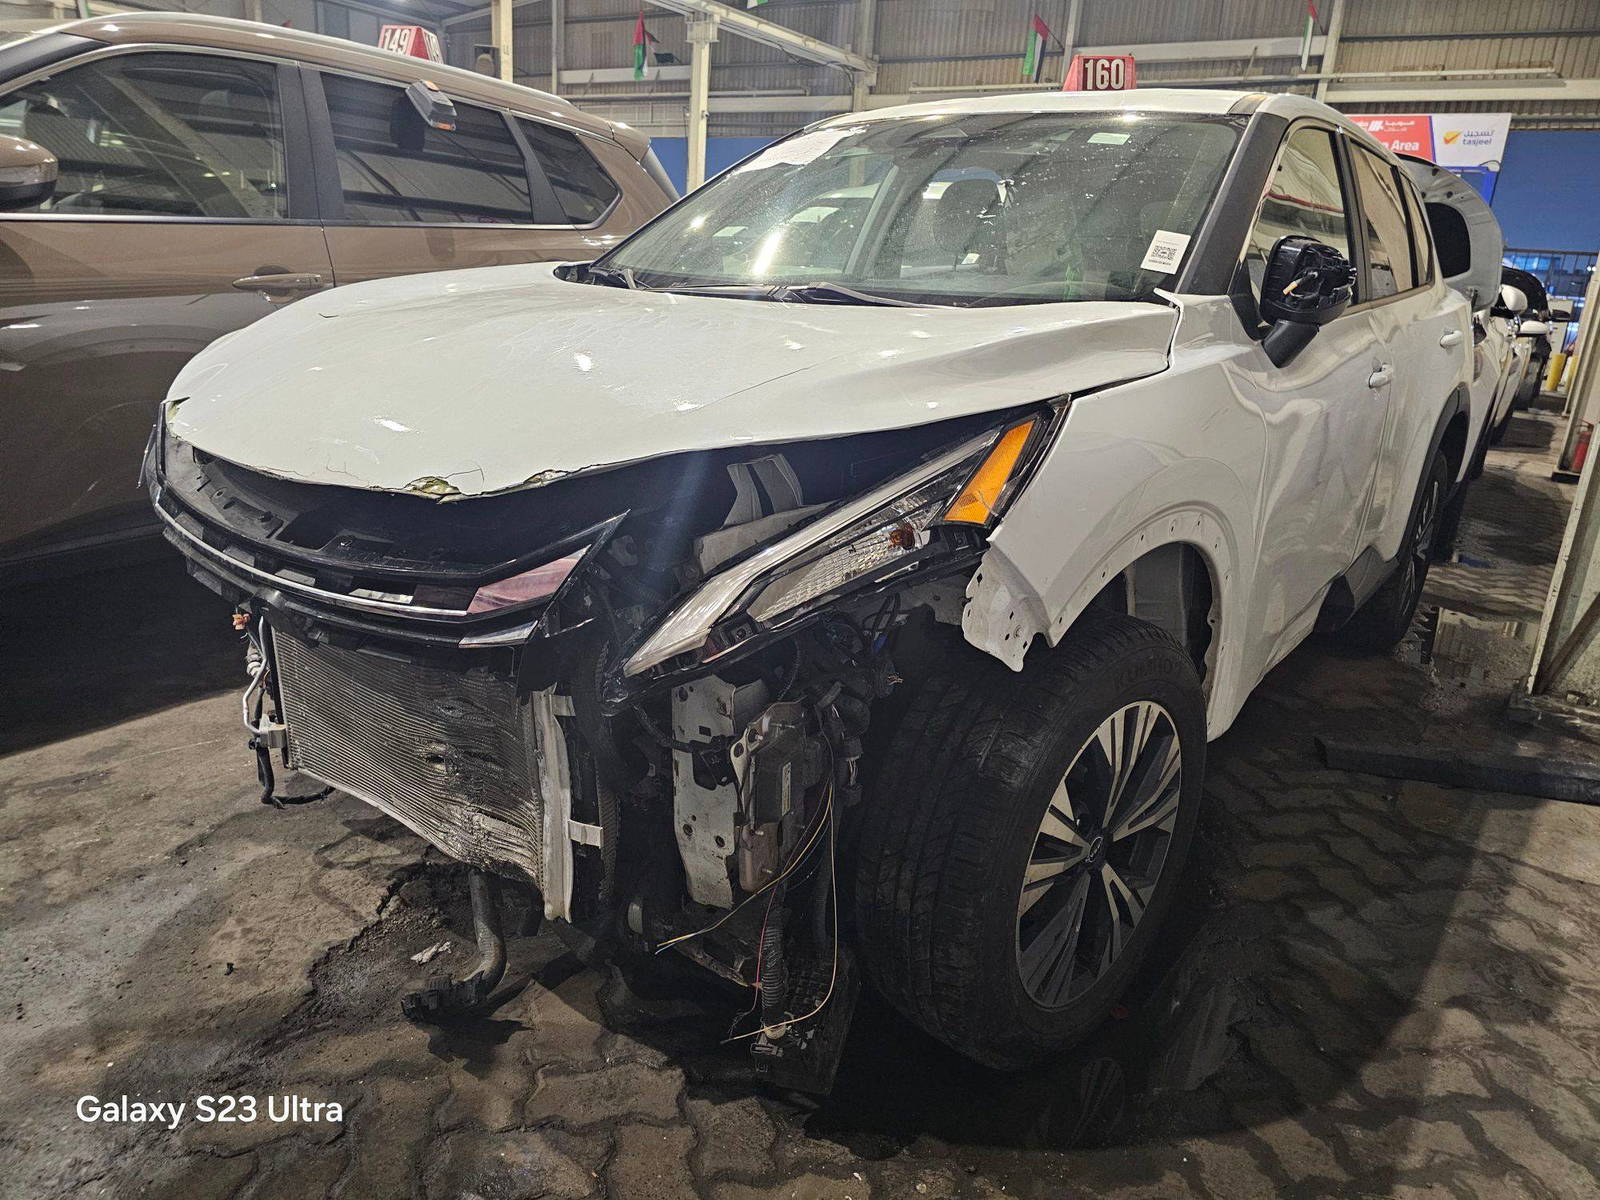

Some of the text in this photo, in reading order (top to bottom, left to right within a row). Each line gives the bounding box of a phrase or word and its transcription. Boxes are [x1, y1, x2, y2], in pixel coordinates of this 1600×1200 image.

[384, 29, 410, 55] 149
[1085, 59, 1124, 90] 160
[1390, 140, 1420, 151] Area
[1463, 138, 1493, 147] tasjeel
